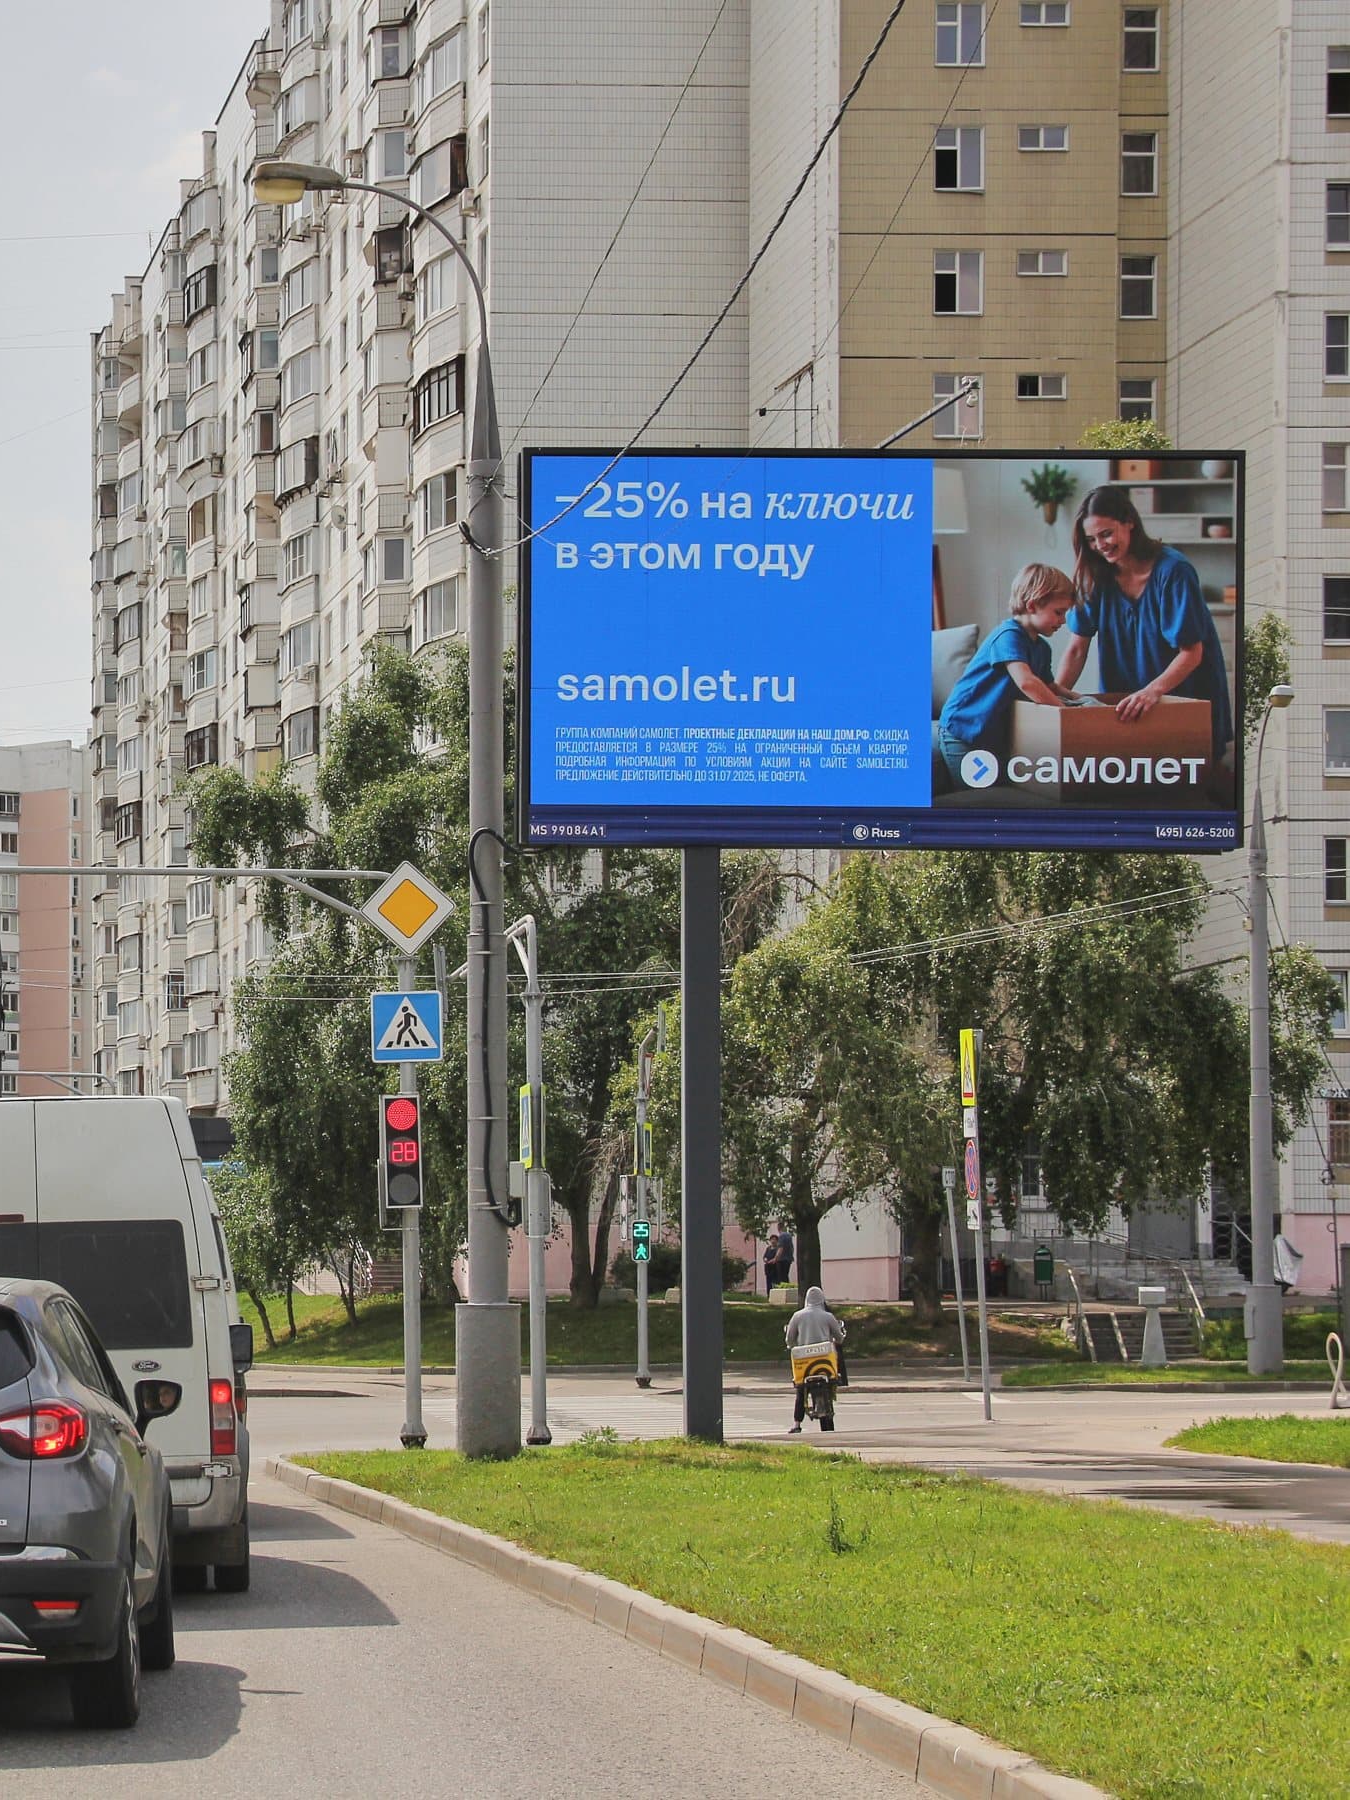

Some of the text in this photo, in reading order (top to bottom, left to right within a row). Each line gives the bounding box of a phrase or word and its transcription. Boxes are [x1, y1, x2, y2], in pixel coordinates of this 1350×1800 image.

[702, 491, 752, 520] на
[764, 491, 915, 521] ключи
[556, 543, 814, 581] в этом году
[557, 665, 796, 703] samolet.ru
[555, 727, 588, 739] ГРУППА
[590, 726, 638, 739] КОМПАНИЙ
[683, 728, 735, 740] ПРОЕКТНЫЕ
[736, 728, 796, 741] ДЕКЛАРАЦИИ
[797, 729, 810, 740] НА
[873, 729, 910, 742] СКИДКА
[555, 741, 909, 755] ПРЕДОСТАВЛЯЕТСЯ В РАЗМЕРЕ 25% НА ОГРАНИЧЕННЫЙ ОБЪЕМ КВАРТИР.
[555, 755, 607, 768] ПОДРОБНАЯ
[615, 755, 676, 768] ИНФОРМАЦИЯ
[684, 756, 697, 768] ПО
[705, 756, 752, 769] УСЛОВИЯМ
[760, 757, 791, 769] АКЦИИ
[799, 757, 811, 768] НА
[820, 756, 848, 769] САЙТЕ
[555, 769, 619, 781] ПРЕДЛОЖЕНИЕ
[620, 769, 692, 782] ДЕЙСТВИТЕЛЬНО
[694, 770, 707, 782] ДО
[758, 771, 770, 782] НЕ
[1007, 755, 1206, 785] самолет
[530, 825, 547, 836] MS
[871, 827, 900, 839] Russ
[1185, 827, 1235, 839] 626-5200
[392, 1142, 417, 1162] 28
